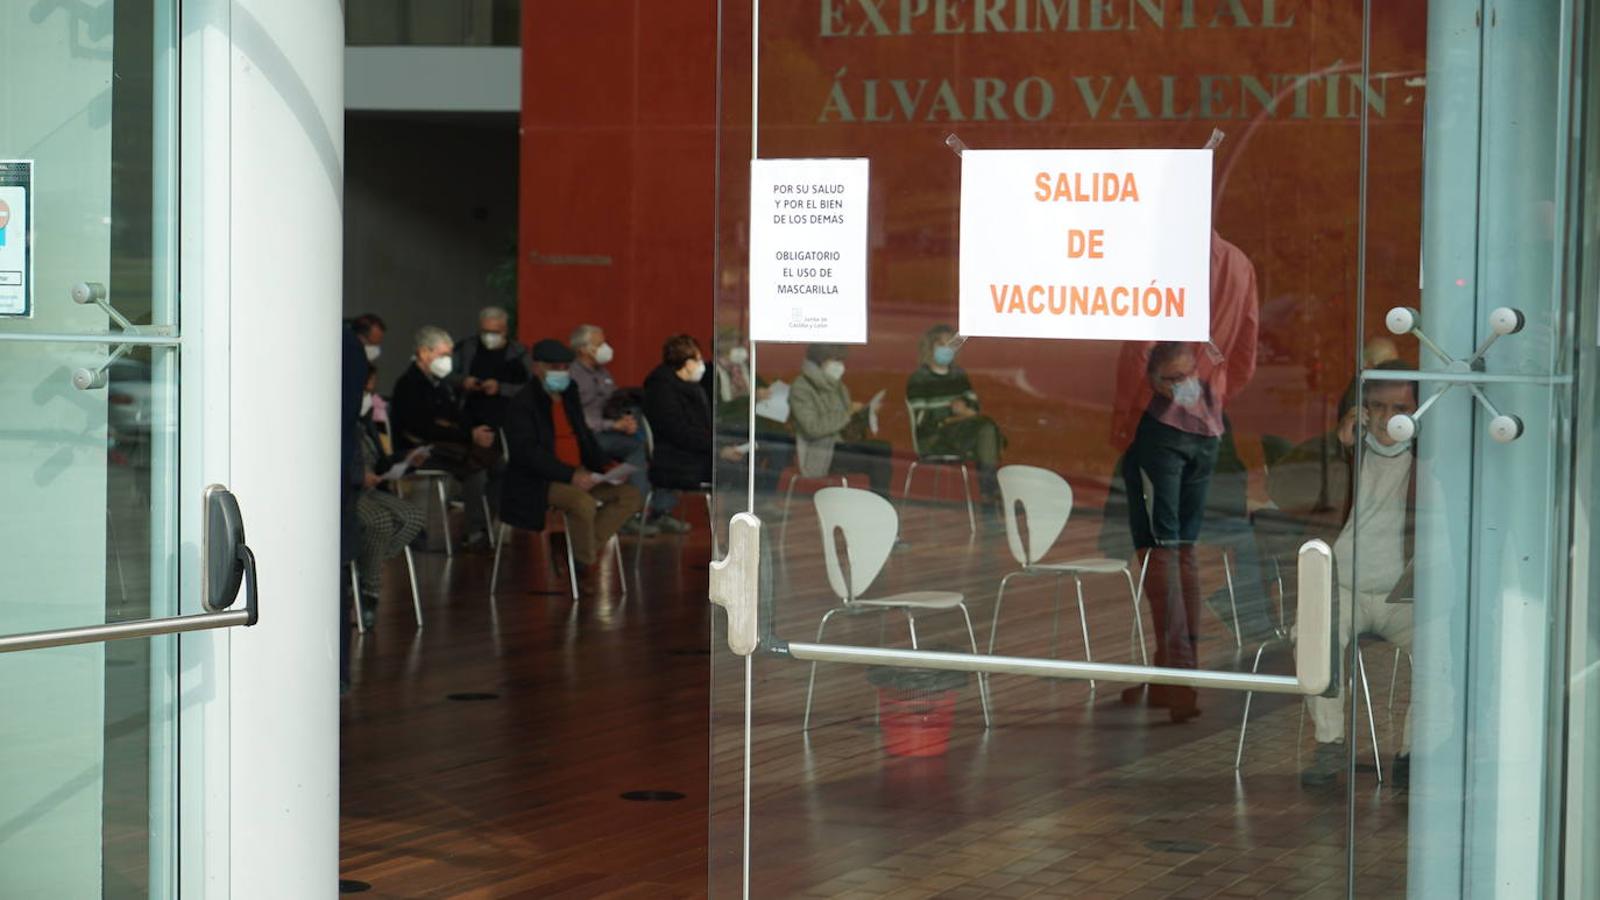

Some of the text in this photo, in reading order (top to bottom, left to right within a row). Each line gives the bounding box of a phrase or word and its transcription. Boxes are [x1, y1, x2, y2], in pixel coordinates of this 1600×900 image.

[819, 0, 1295, 37] EXPERIMENTAL
[818, 59, 1388, 123] ÁLVARO VALENTÍN
[773, 184, 845, 195] POR SU SALUD
[1034, 171, 1140, 202] SALIDA
[774, 199, 843, 210] Y POR EL BIEN
[773, 214, 844, 225] DE LOS DEMAS
[1067, 229, 1104, 259] DE
[775, 251, 841, 261] OBLIGATORIO
[782, 267, 833, 278] EL USO DE
[777, 284, 839, 295] MASCARILLA
[990, 279, 1186, 318] VACUNACIÓN
